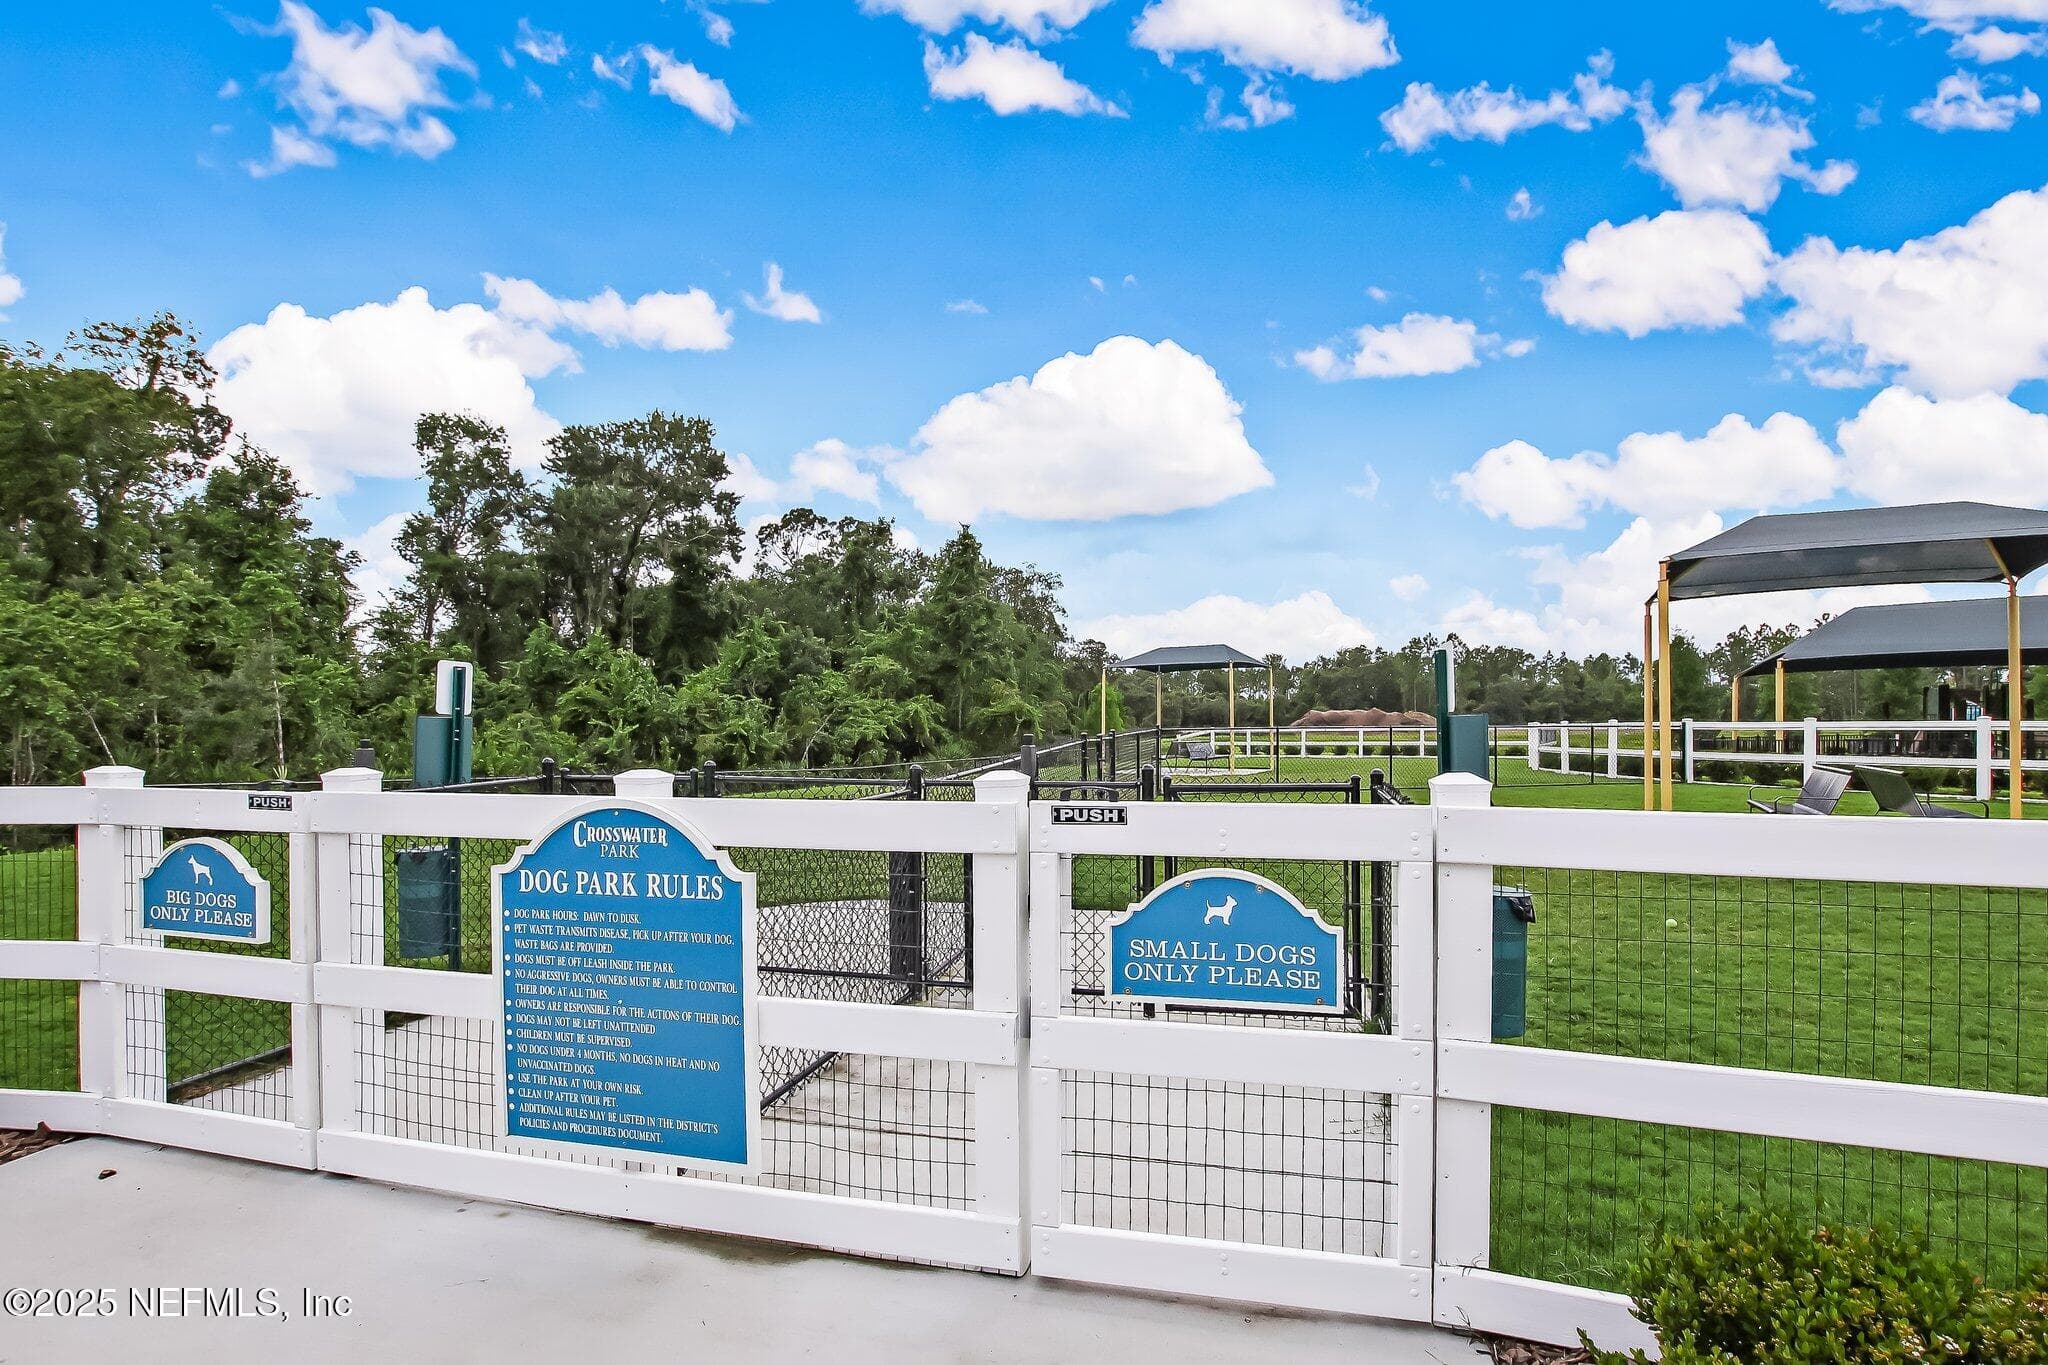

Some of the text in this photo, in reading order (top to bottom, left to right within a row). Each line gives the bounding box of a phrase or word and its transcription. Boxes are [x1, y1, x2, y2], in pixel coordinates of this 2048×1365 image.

[253, 797, 287, 808] PUSH
[1059, 809, 1118, 822] PUSH
[600, 845, 639, 858] PARK
[519, 869, 724, 901] DOG PARK RULES
[166, 890, 237, 908] BIG DOGS
[150, 906, 252, 927] ONLY PLEASE
[514, 909, 641, 924] DOG PARK HOURS: DAWN TO DUSK.
[514, 924, 734, 945] PET WASTE TRANSMITS DISEASE, PICK UP AFTER YOUR DOG.
[515, 939, 614, 954] WASTE BAGS ARE PROVIDED.
[1129, 939, 1316, 966] SMALL DOGS
[514, 954, 675, 973] DOGS MUST BE OFF LEASH INSIDE THE PARK.
[515, 969, 738, 993] NO AGGRESSIVE DOGS, OWNERS MUST BE ABLE TO CONTROL
[1124, 962, 1320, 990] ONLY PLEASE
[515, 984, 609, 999] THEIR DOG AT ALL TIMES.
[516, 1000, 741, 1026] OWNERS ARE RESPONSIBLE FOR THE ACTIONS OF THEIR DOG.
[516, 1014, 655, 1034] DOGS MAY NOT BE LEFT UNATTENDED
[516, 1029, 632, 1048] CHILDREN MUST BE SUPERVISED.
[517, 1043, 719, 1071] NO DOGS UNDER 4 MONTHS, NO DOGS IN HEAT AND NO
[517, 1058, 595, 1075] UNVACCINATED DOGS.
[518, 1073, 643, 1095] USE THE PARK AT YOUR OWN RISK.
[519, 1088, 618, 1108] CLEAN UP AFTER YOUR PET.
[519, 1103, 718, 1134] ADDITIONAL RULES MAY BE LISTED IN THE DISTRICT'S
[520, 1117, 663, 1143] POLICIES AND PROCEDURES DOCUMENT.
